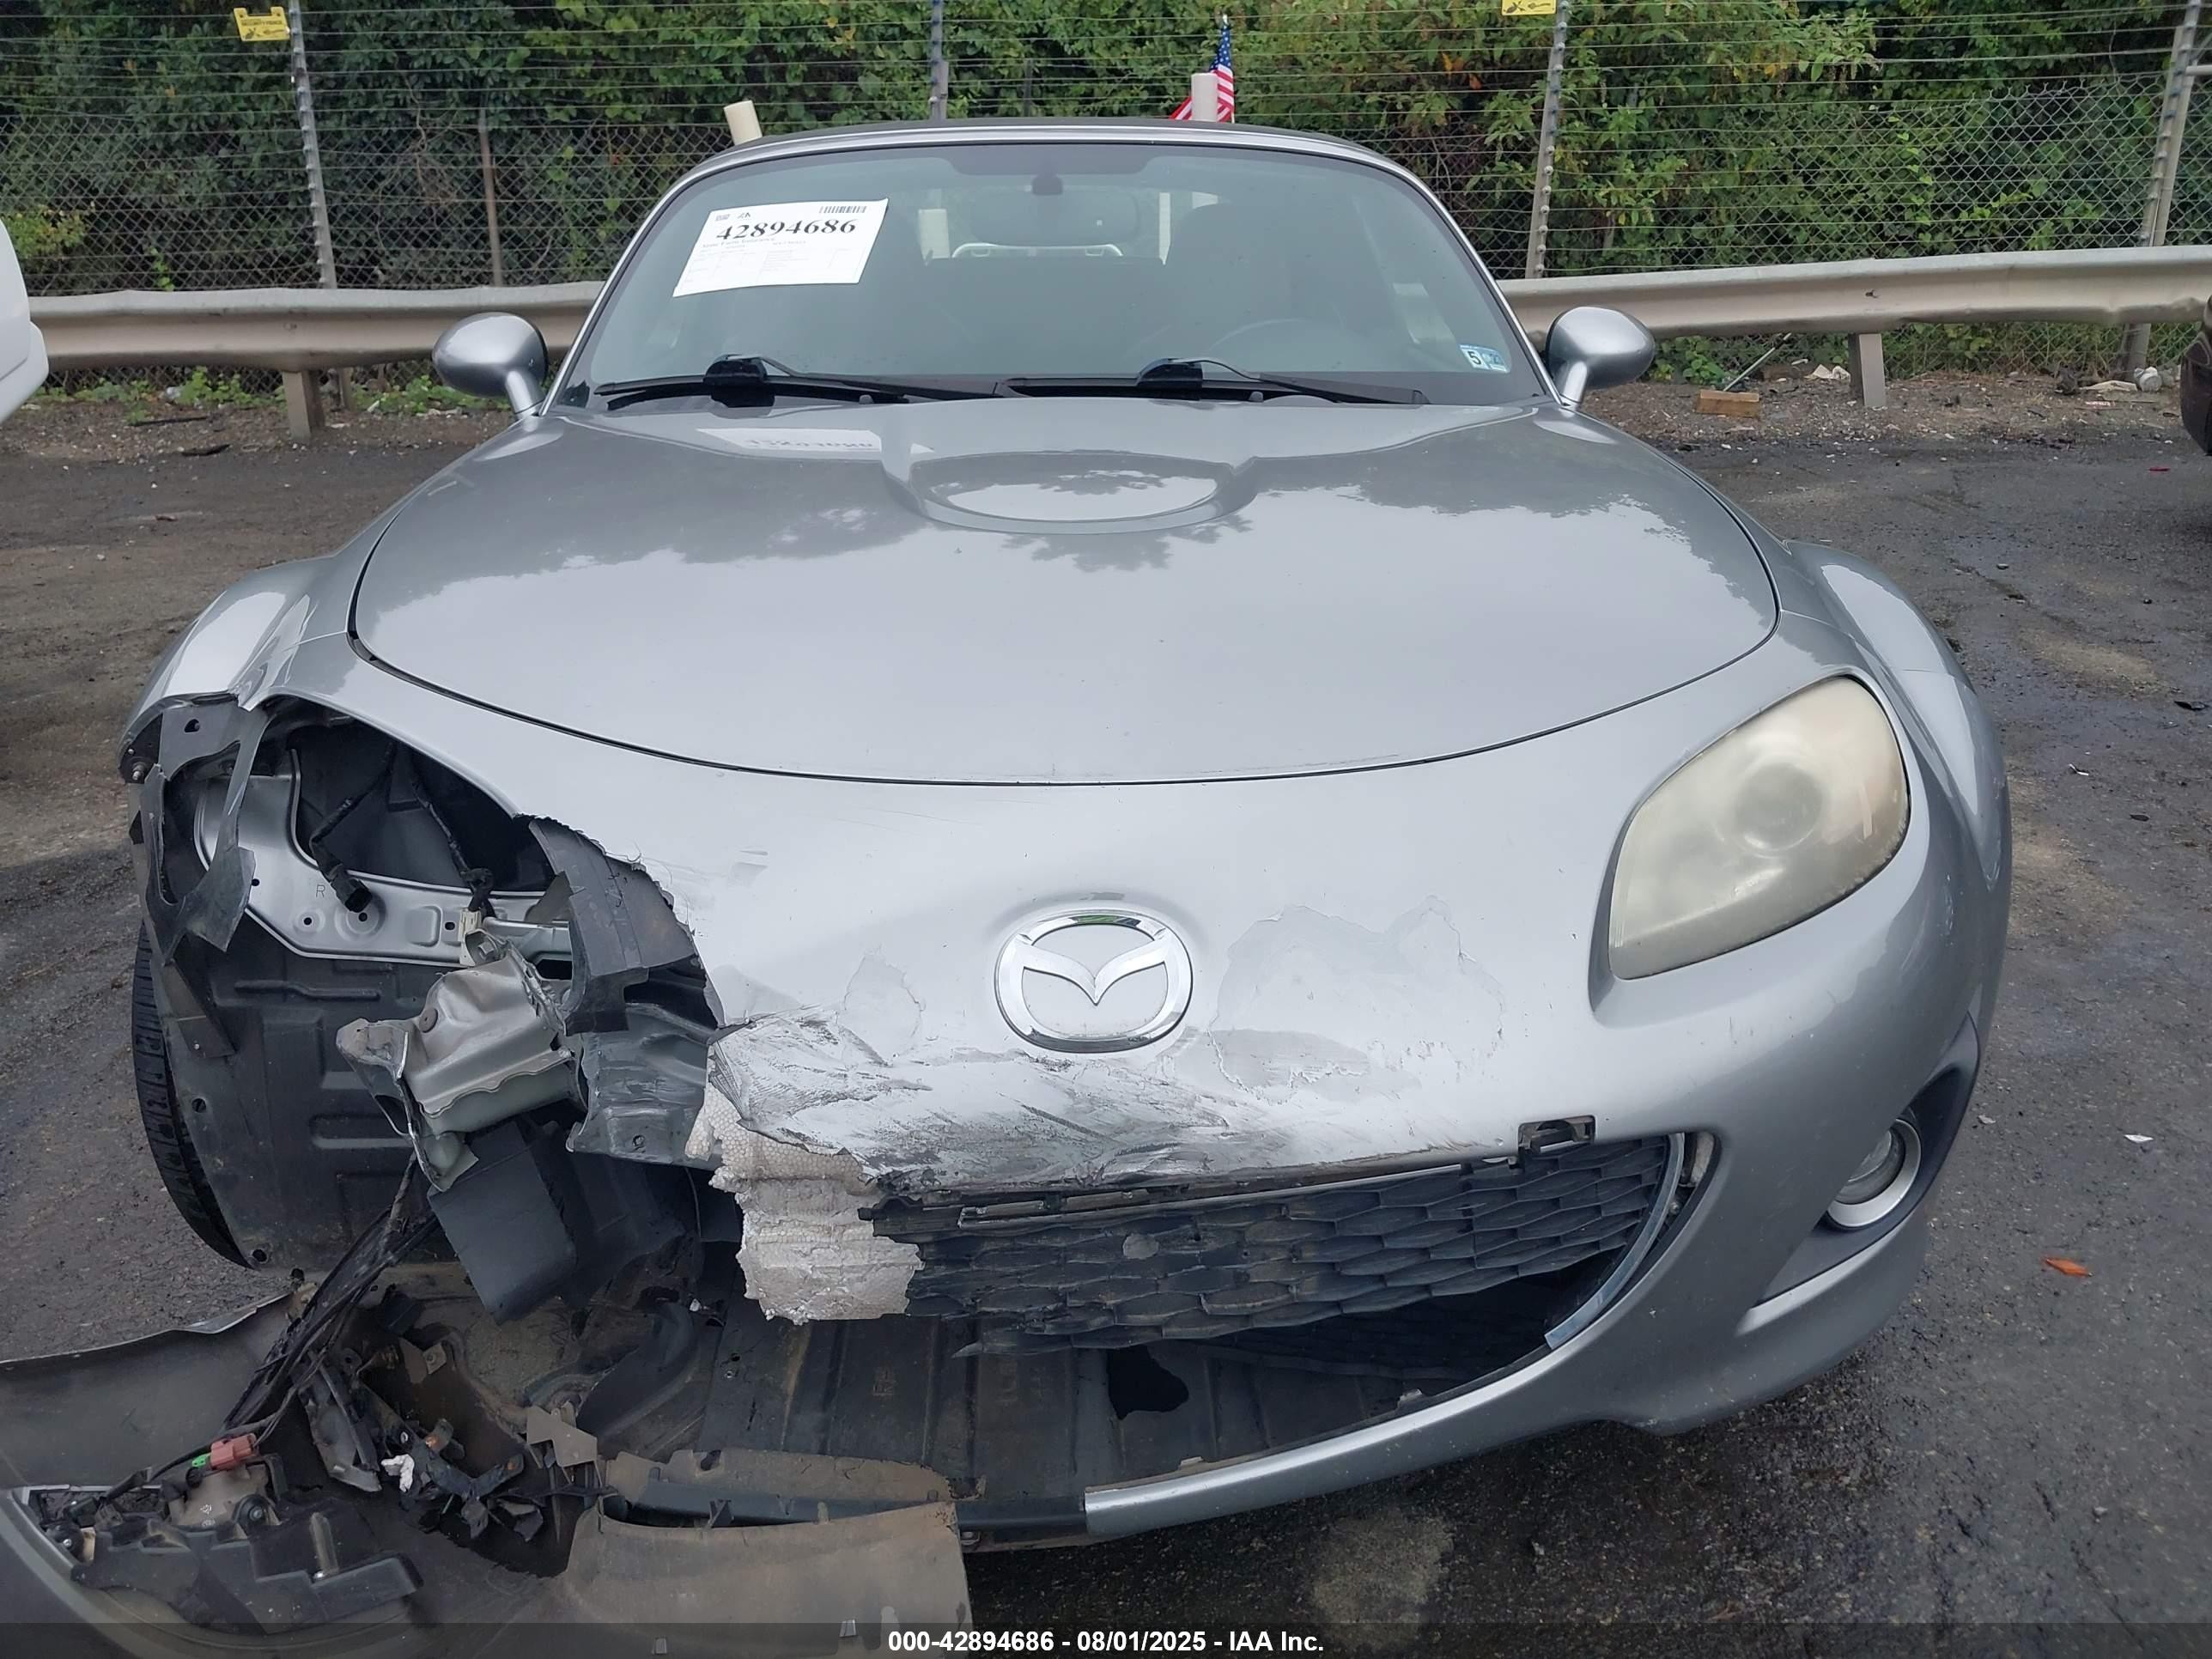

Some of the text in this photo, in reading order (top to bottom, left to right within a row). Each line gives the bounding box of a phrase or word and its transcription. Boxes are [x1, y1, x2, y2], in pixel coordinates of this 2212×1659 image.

[716, 219, 859, 240] 42894686
[1468, 350, 1481, 365] 5
[316, 884, 325, 898] R
